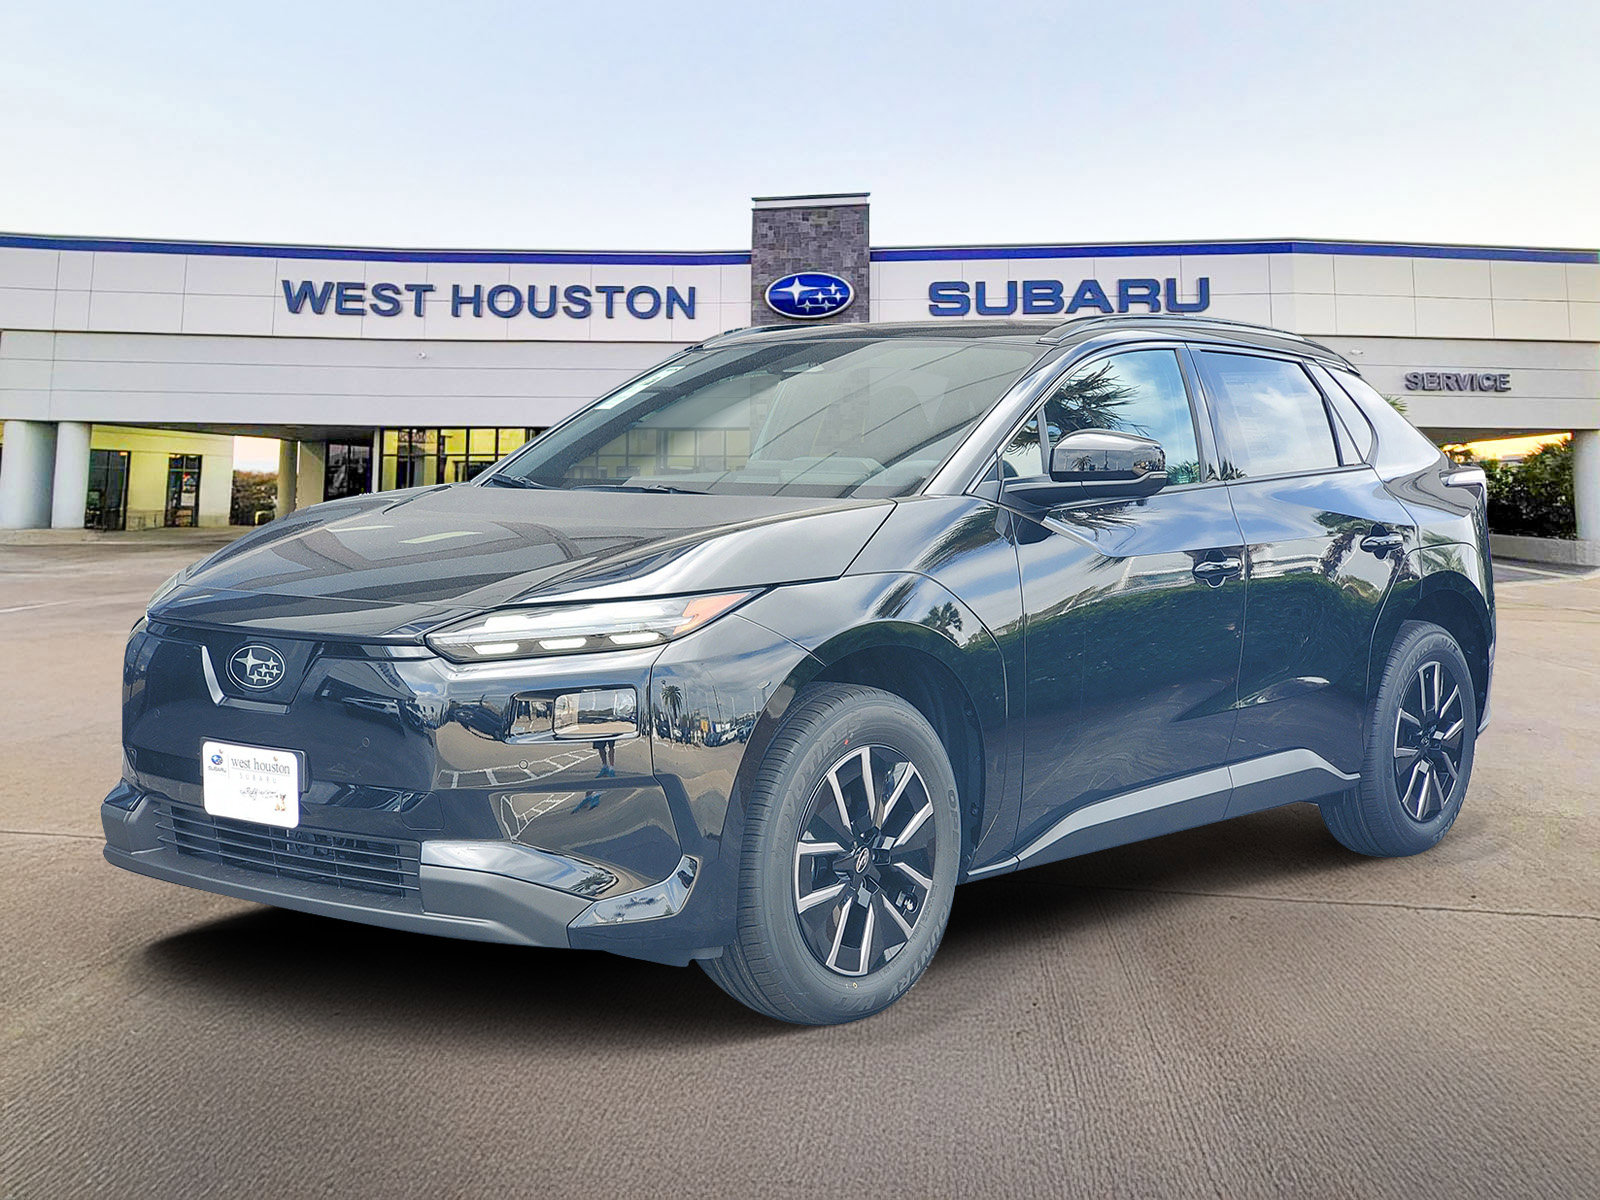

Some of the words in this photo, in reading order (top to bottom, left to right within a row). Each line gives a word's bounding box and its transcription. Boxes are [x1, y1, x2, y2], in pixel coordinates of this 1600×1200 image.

[282, 279, 436, 318] WEST
[451, 284, 696, 320] HOUSTON
[929, 277, 1210, 317] SUBARU
[1405, 371, 1512, 393] SERVICE
[231, 757, 251, 770] west
[253, 757, 291, 775] houston
